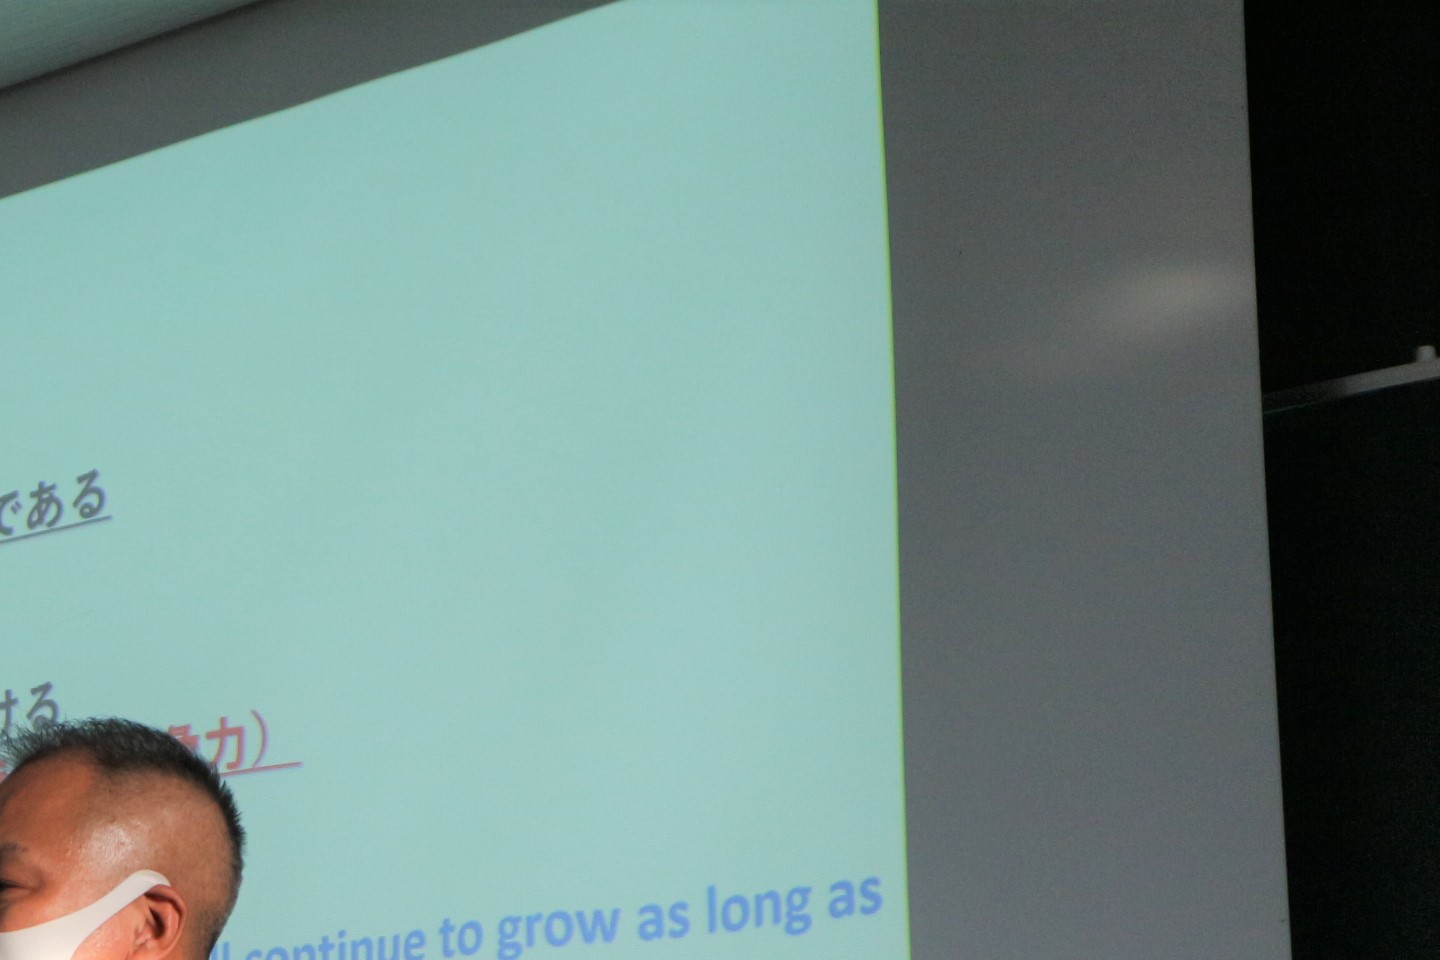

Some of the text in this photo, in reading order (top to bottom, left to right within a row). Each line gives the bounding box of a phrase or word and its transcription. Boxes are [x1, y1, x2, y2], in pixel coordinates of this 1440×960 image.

[439, 916, 483, 959] to
[637, 896, 691, 942] as
[706, 883, 813, 936] long
[827, 875, 884, 920] as
